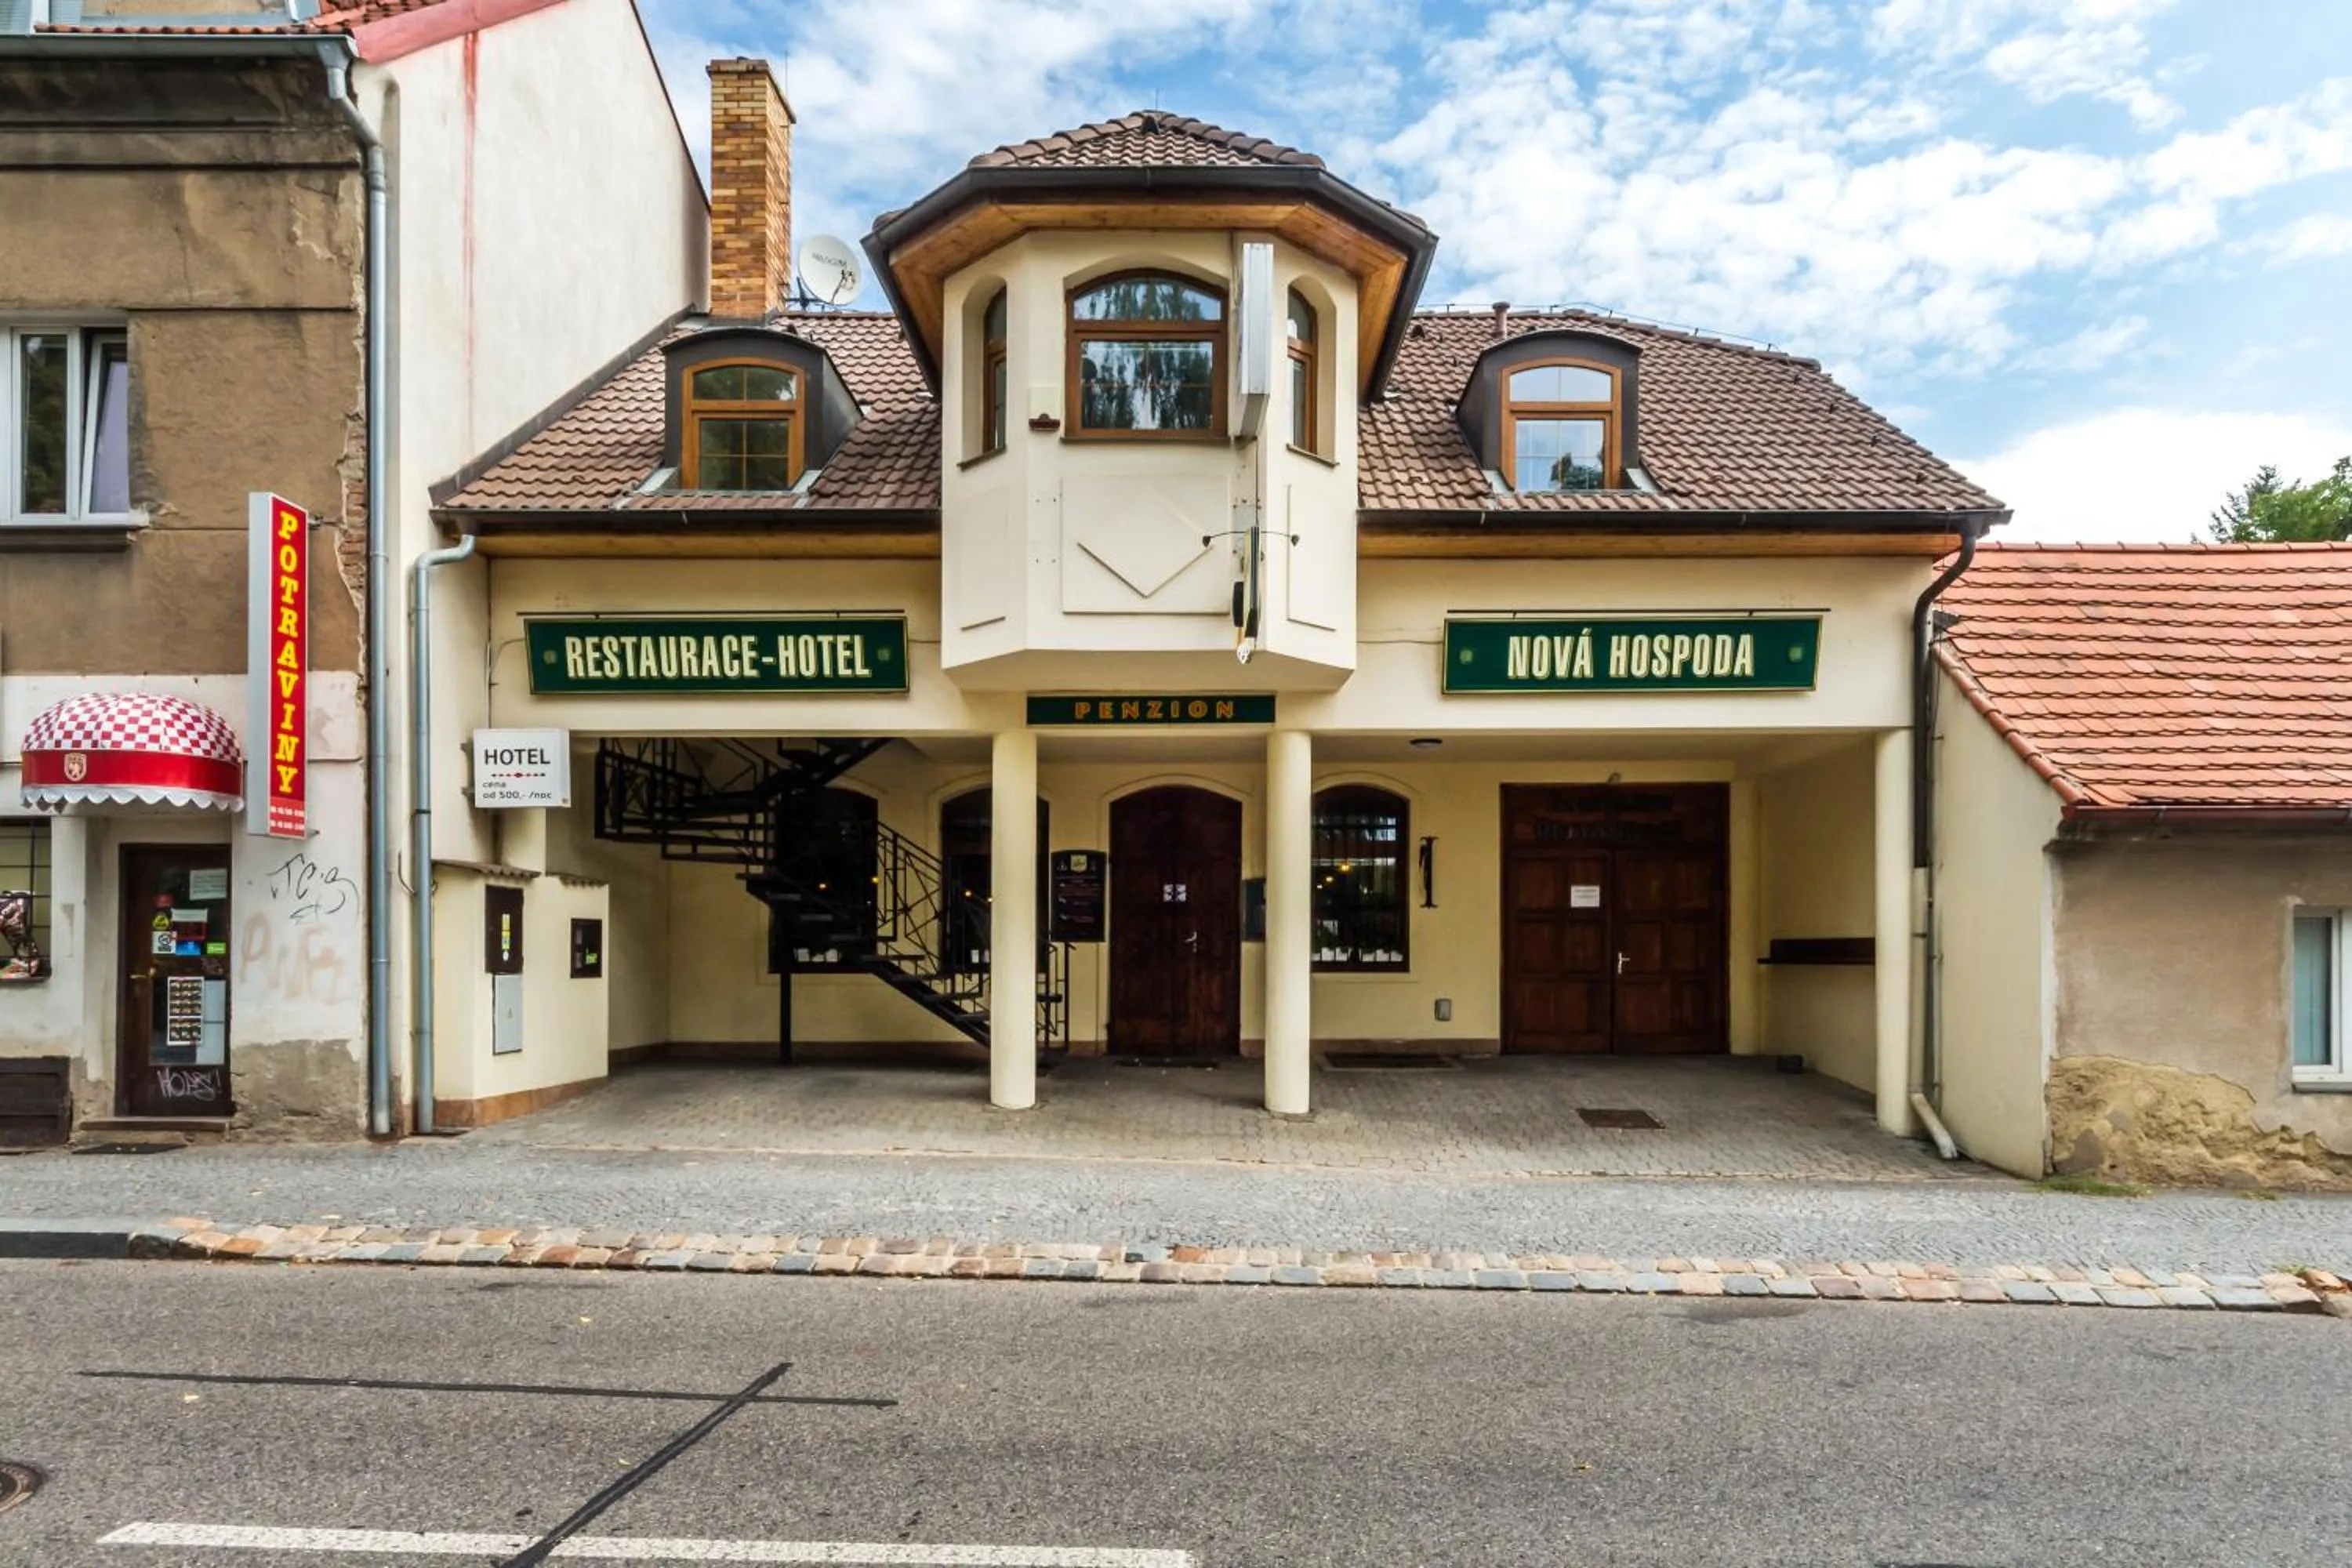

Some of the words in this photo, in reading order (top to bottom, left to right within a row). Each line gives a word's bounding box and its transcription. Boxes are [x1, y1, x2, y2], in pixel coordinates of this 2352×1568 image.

[277, 510, 299, 793] POTRAVINY
[564, 633, 872, 679] RESTAURACE-HOTEL
[1507, 628, 1594, 680] NOVÁ
[1609, 633, 1755, 678] HOSPODA
[1074, 700, 1234, 720] PENZION
[484, 748, 551, 765] HOTEL
